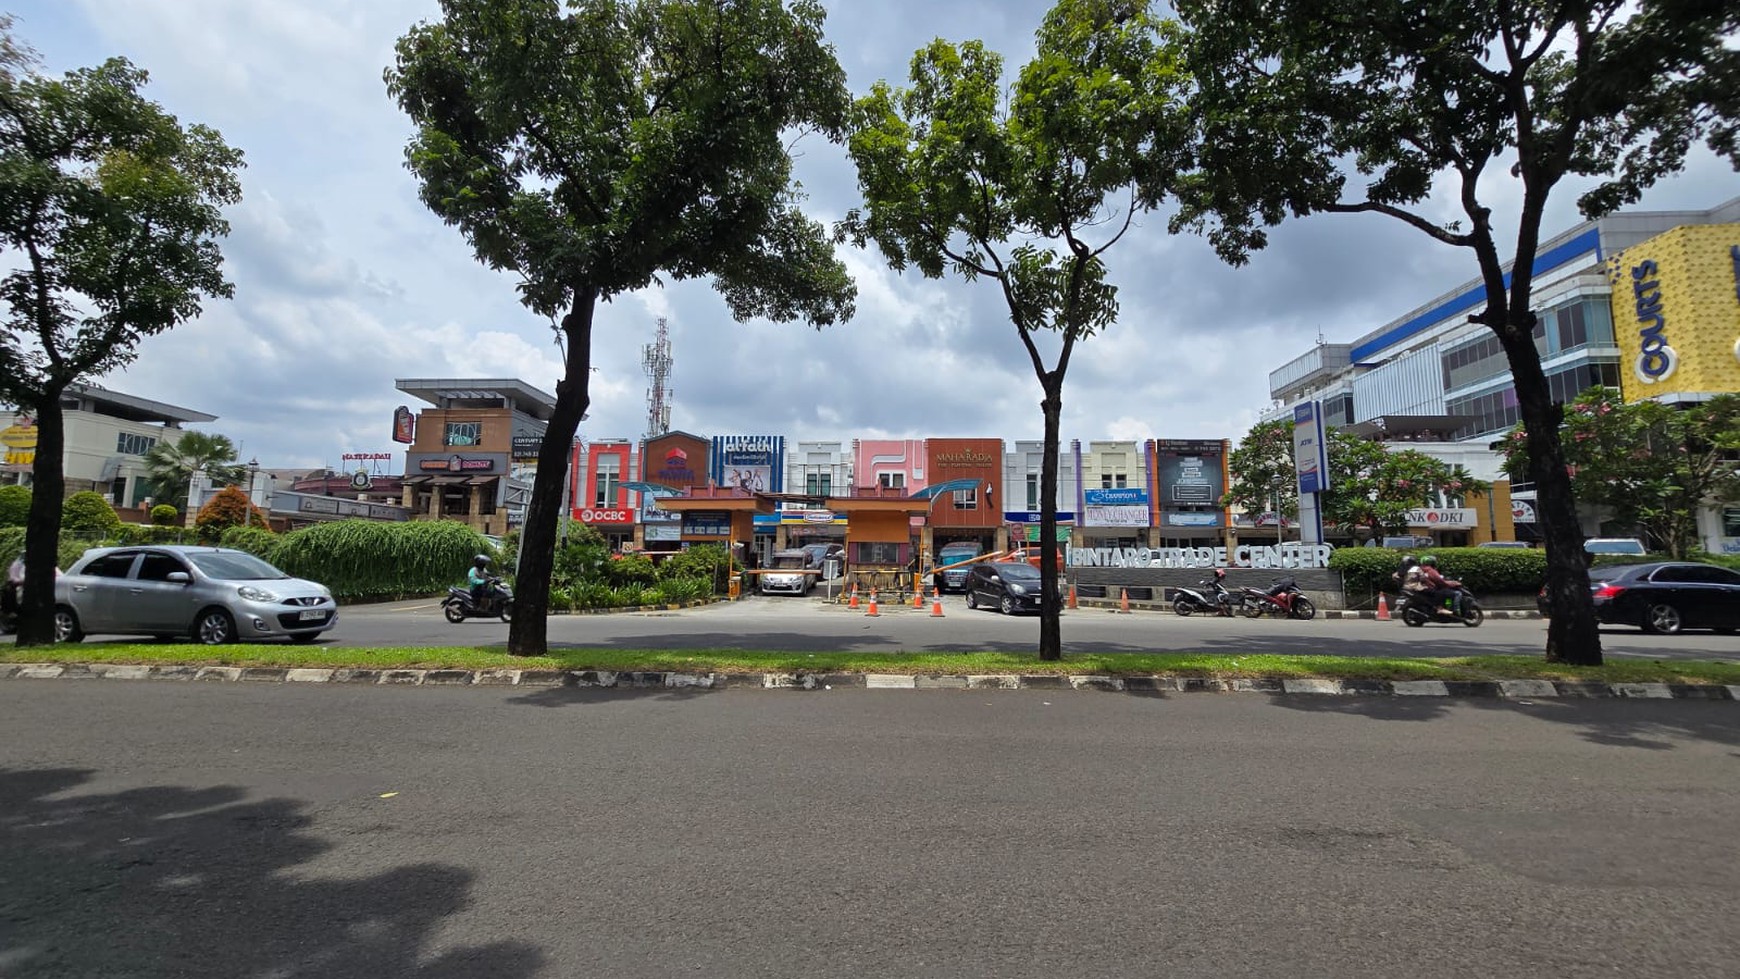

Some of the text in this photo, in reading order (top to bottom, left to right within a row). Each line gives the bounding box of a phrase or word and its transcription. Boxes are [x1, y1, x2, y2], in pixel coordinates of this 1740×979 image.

[1631, 259, 1670, 376] COURTS
[594, 511, 626, 521] OCBC
[1440, 512, 1463, 523] DKI
[1072, 544, 1331, 568] BINTARO TRADE CENTER
